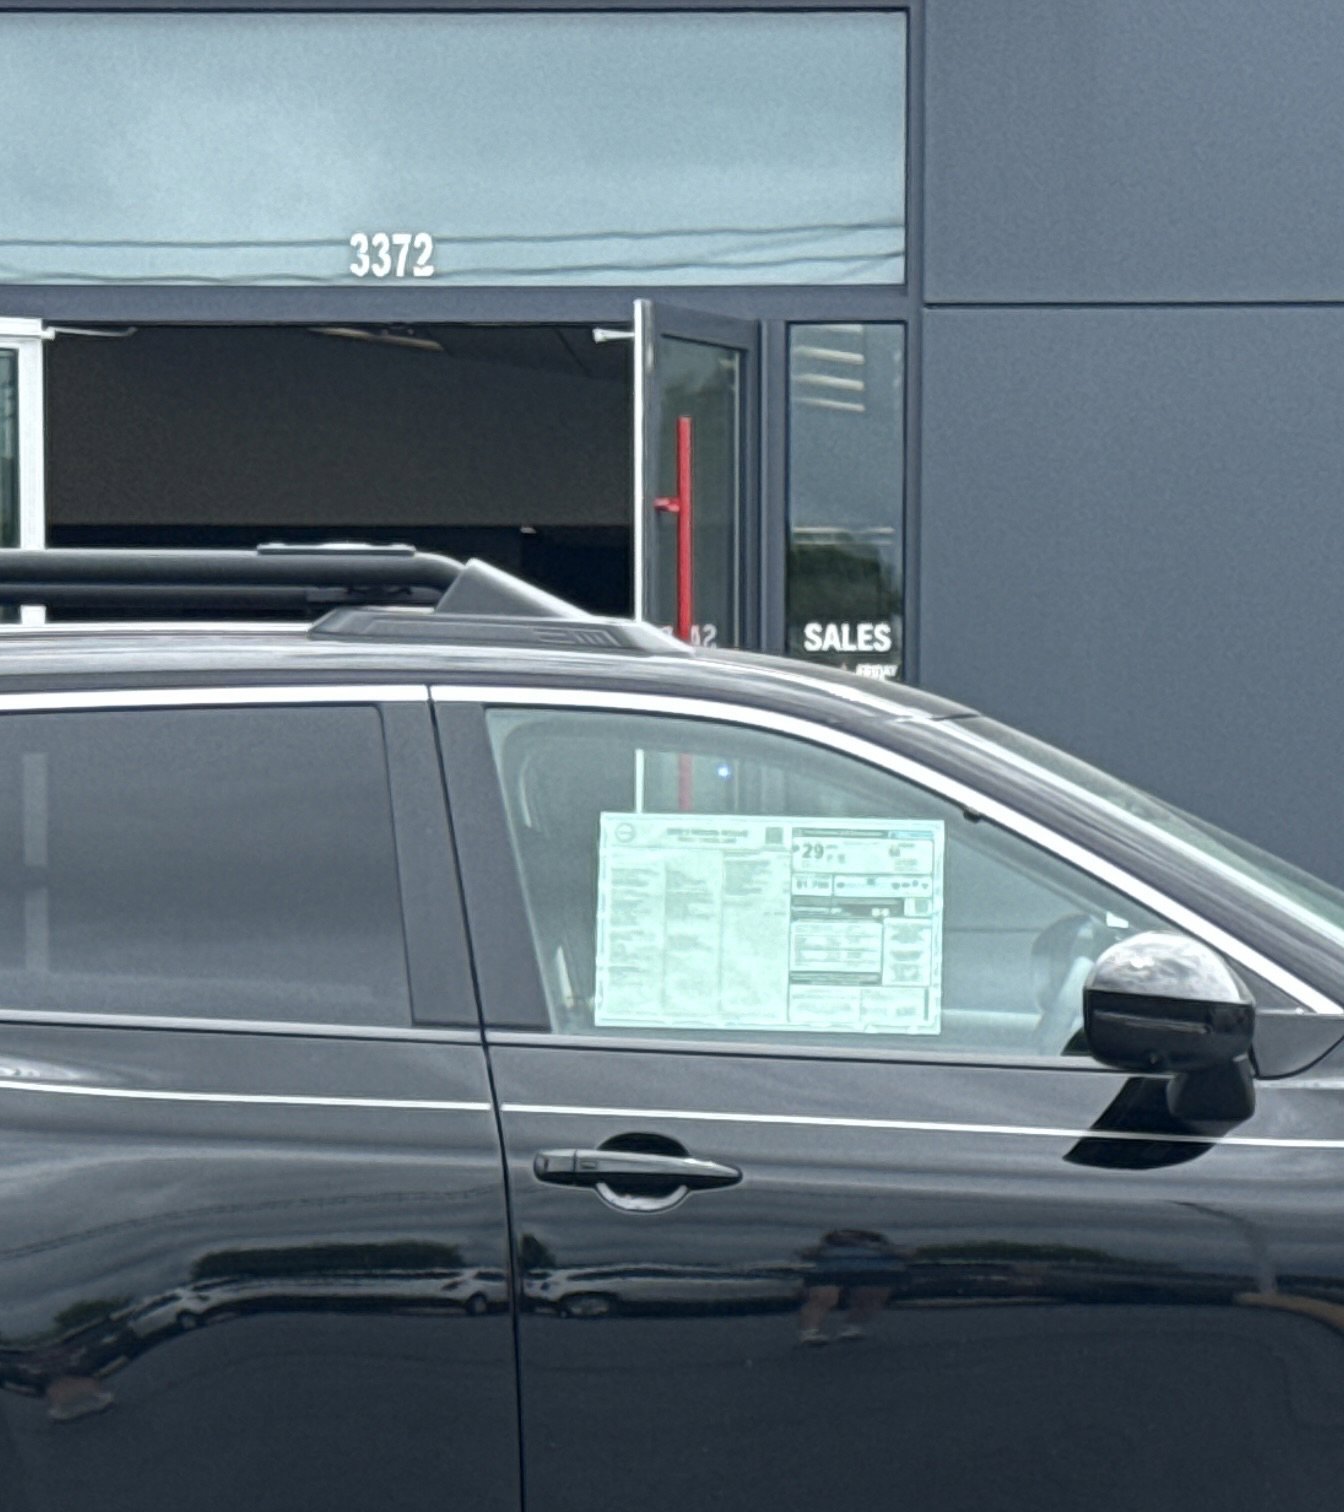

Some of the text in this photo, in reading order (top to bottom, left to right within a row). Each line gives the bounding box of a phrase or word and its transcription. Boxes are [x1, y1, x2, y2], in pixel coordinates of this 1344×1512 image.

[350, 232, 434, 277] 3372
[804, 623, 892, 652] SALES
[801, 843, 825, 859] 29
